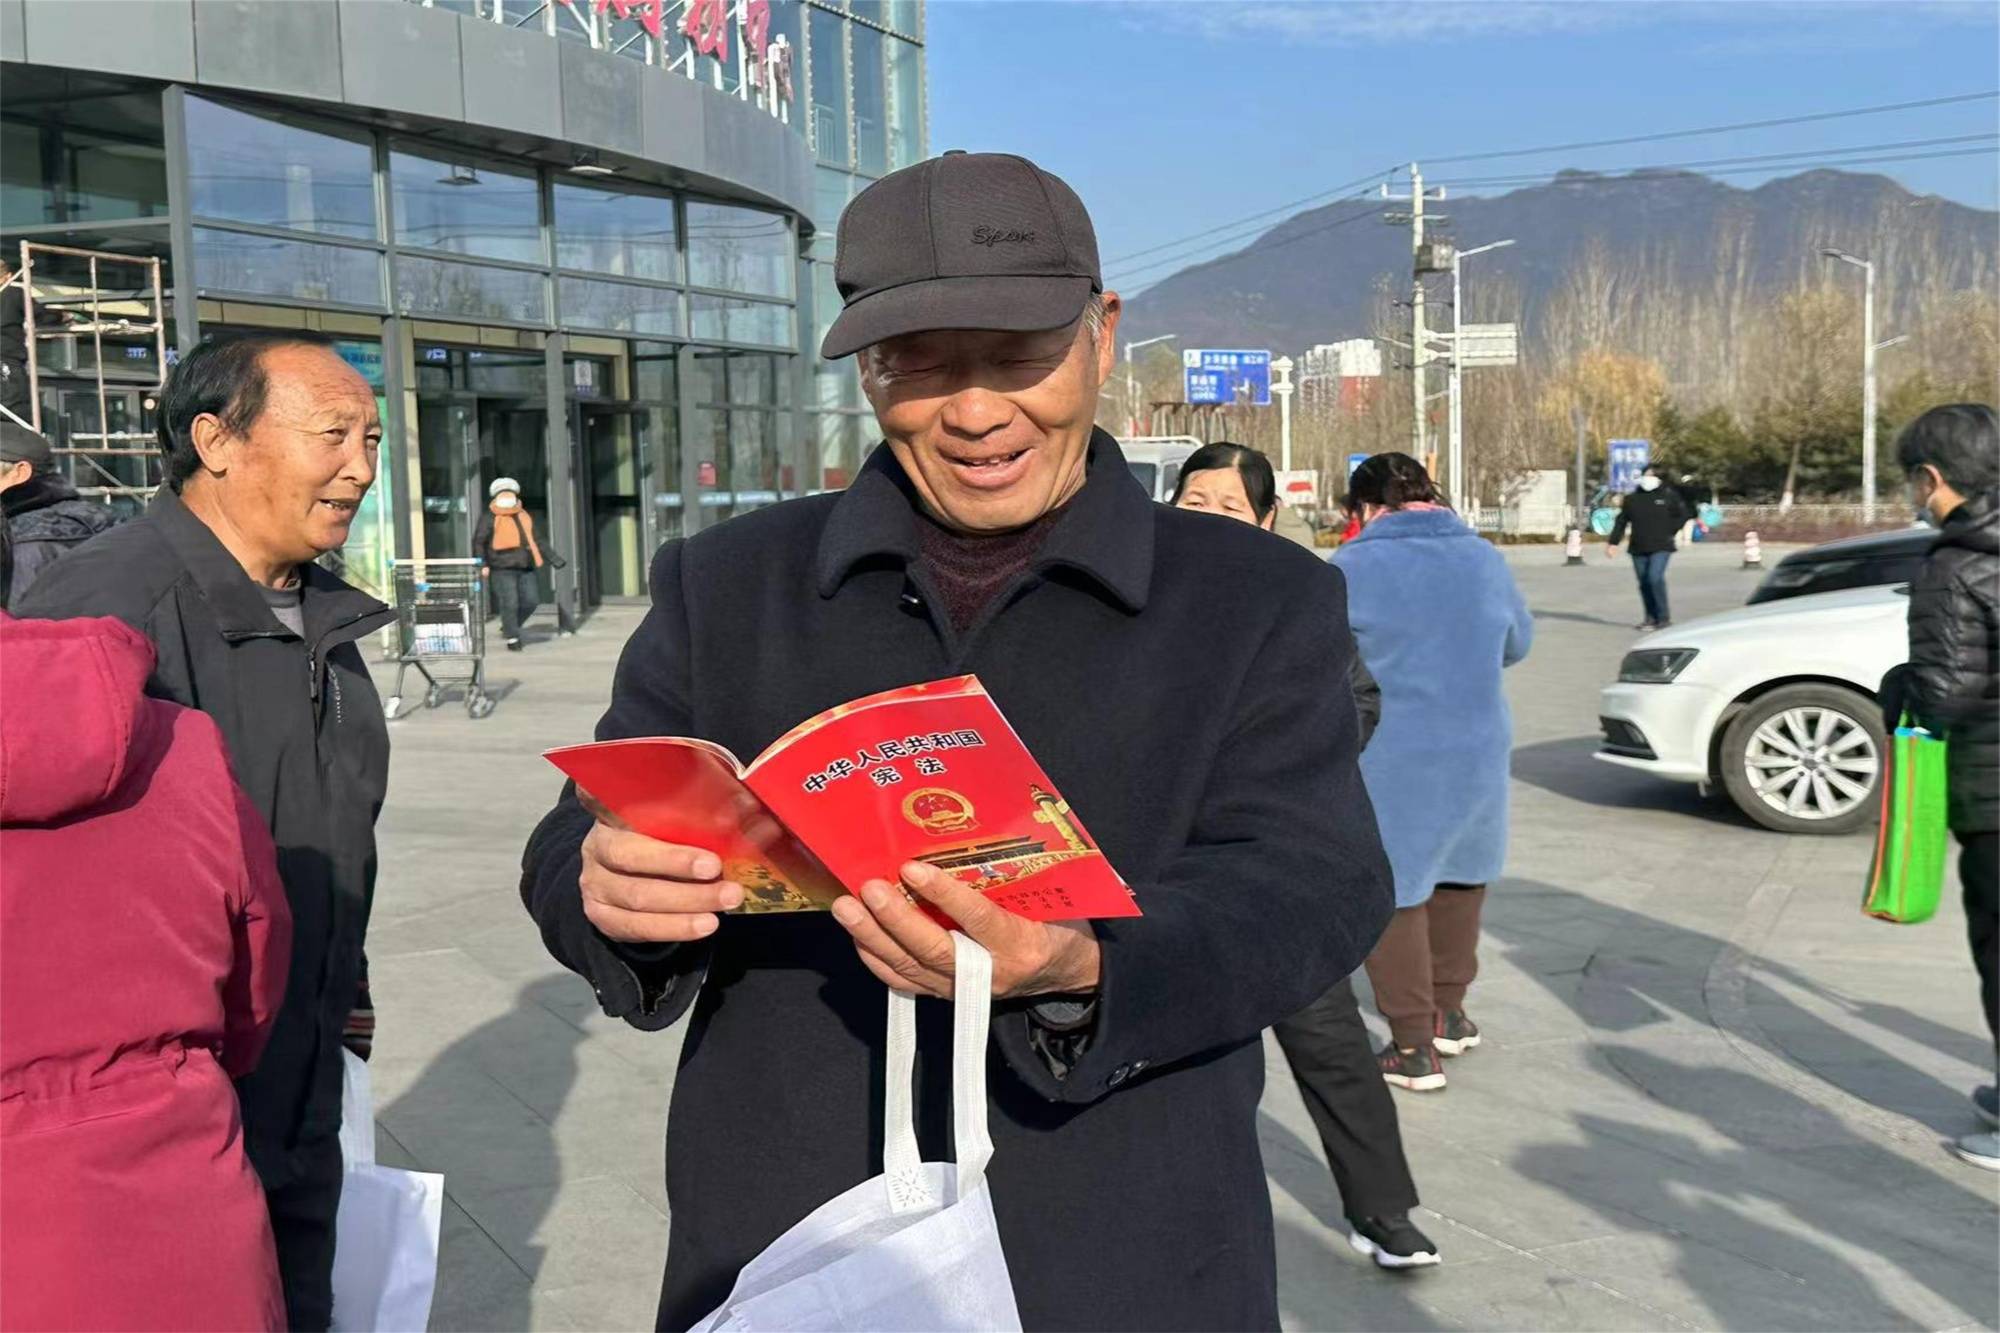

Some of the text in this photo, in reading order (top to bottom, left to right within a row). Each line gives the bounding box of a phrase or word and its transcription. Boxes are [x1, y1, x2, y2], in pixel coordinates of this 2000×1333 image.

[804, 730, 985, 792] 中华人民共和国
[871, 758, 948, 786] 宪法
